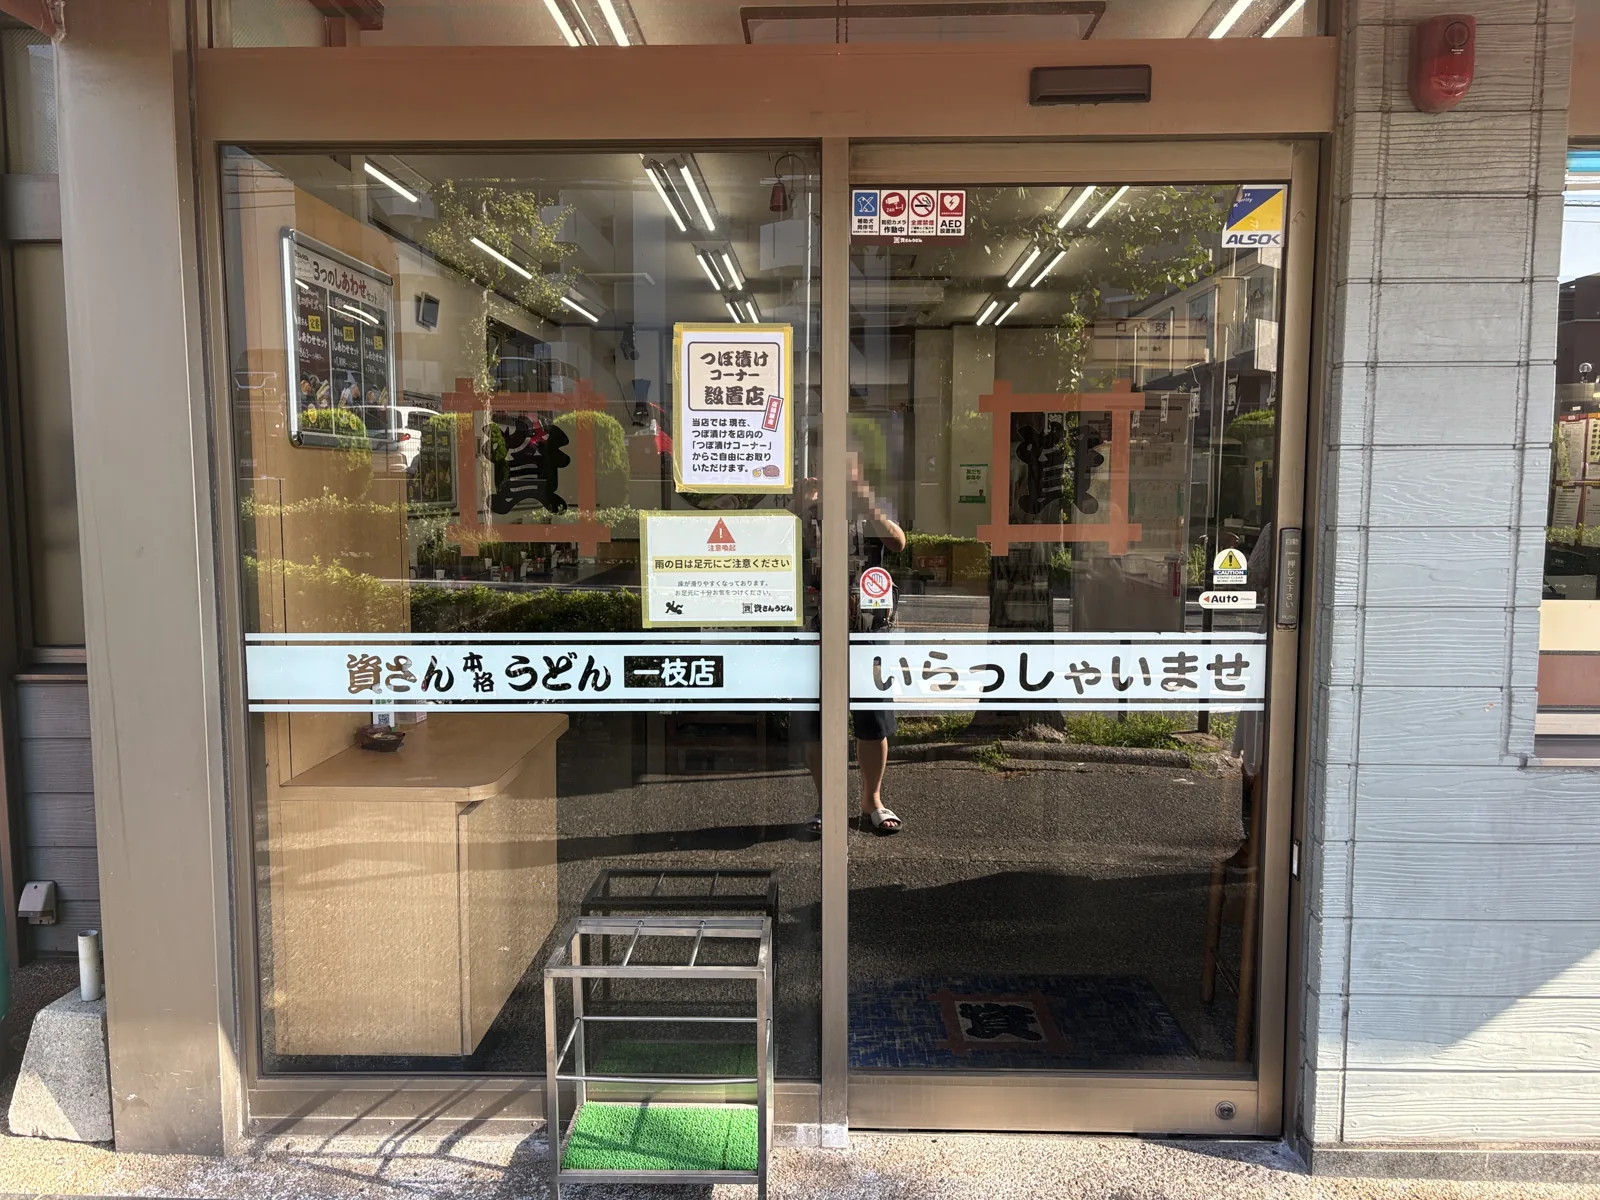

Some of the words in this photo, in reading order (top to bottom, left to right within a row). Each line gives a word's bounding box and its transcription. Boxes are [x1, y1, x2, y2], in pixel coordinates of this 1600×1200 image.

[940, 220, 962, 228] AED
[884, 226, 905, 234] 作動中
[1226, 234, 1281, 245] ALSOK
[298, 331, 328, 348] しあわせセット
[334, 341, 360, 356] しあわせセット
[700, 350, 769, 368] つぼ漬け
[710, 369, 760, 381] コーナー
[704, 386, 765, 406] 設置店
[692, 418, 751, 427] 当店では現在、
[692, 430, 763, 439] つぼ漬けを店内の
[692, 441, 772, 450] 「つぼ漬けコーナー」
[692, 452, 772, 462] からご自由にお取り
[692, 464, 749, 473] いただけます。
[1285, 538, 1299, 546] 自動
[708, 544, 736, 552] 注意喚起
[654, 558, 790, 570] 雨の日は足元にご注意ください
[1286, 560, 1296, 608] 押して下さい
[675, 589, 772, 597] お足元に十分お気をつけください。
[1211, 595, 1239, 603] Auto
[754, 603, 793, 613] 資さんうどん
[347, 653, 455, 695] 資さん
[462, 651, 495, 693] 本格
[505, 652, 612, 692] うどん
[632, 658, 714, 686] 一枝店
[872, 650, 1251, 695] いらっしゃいませ
